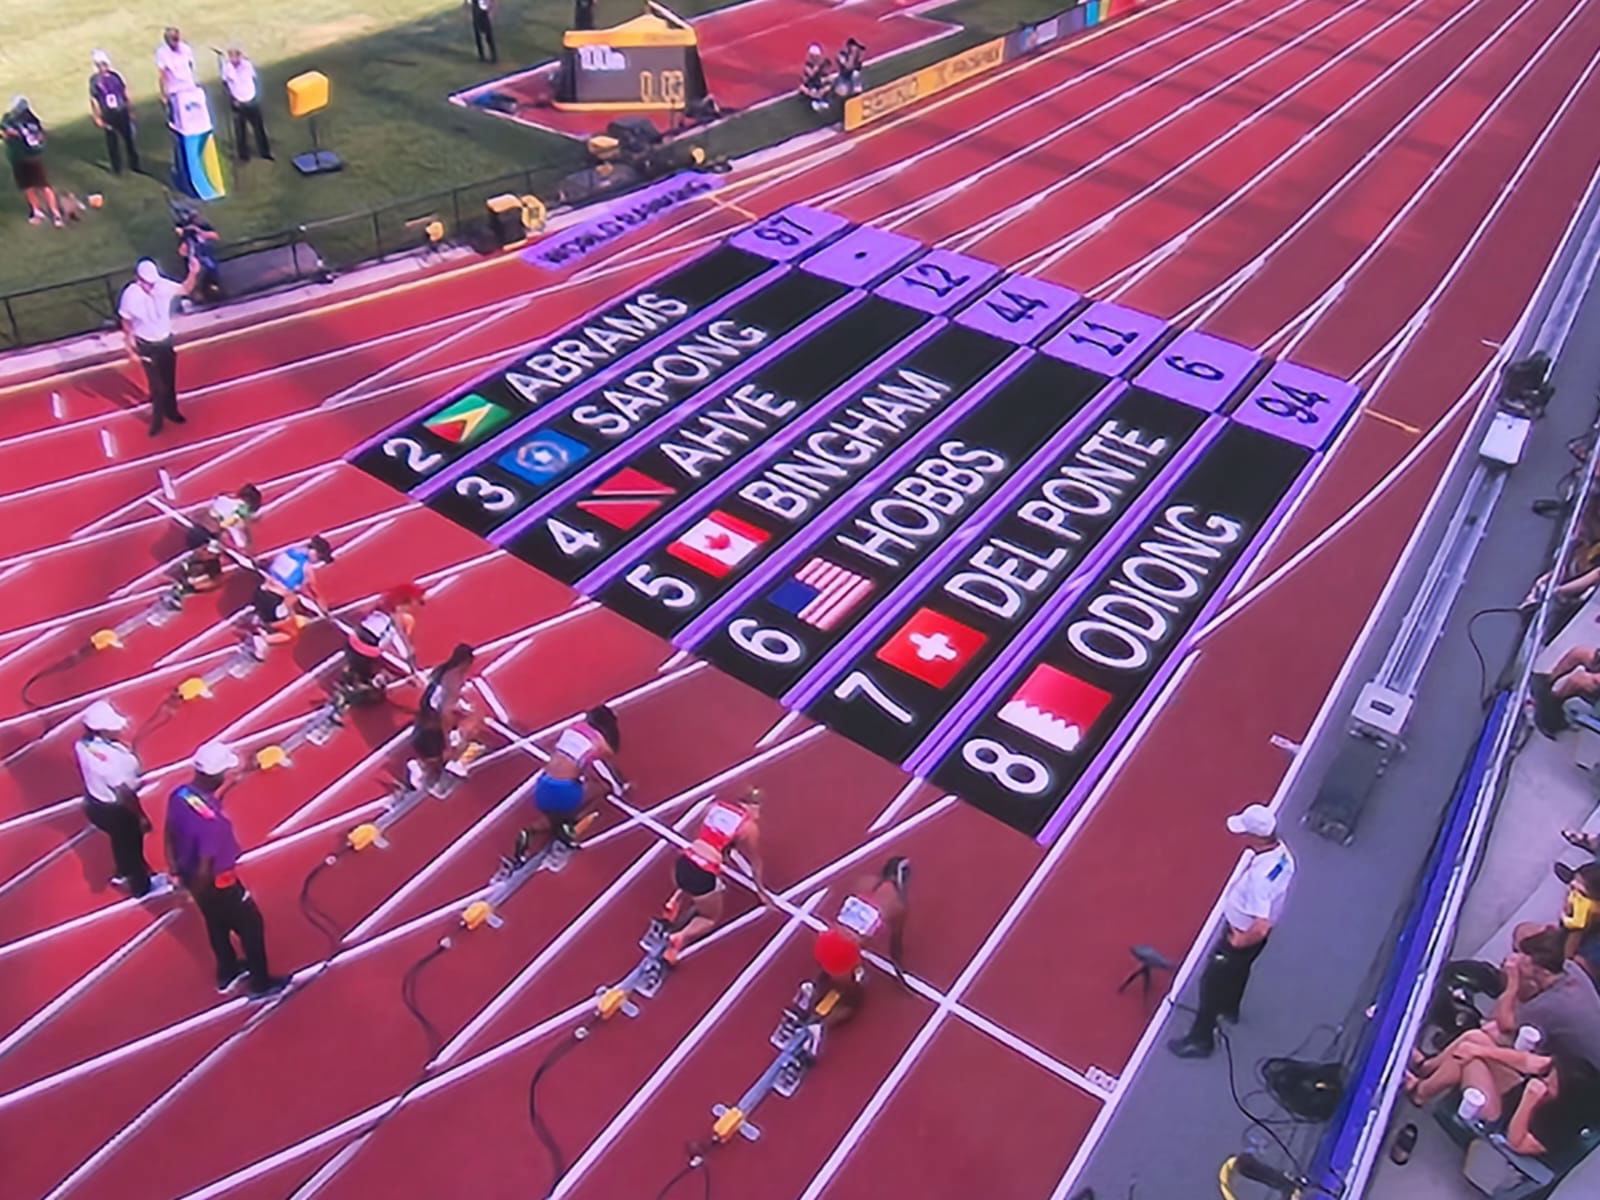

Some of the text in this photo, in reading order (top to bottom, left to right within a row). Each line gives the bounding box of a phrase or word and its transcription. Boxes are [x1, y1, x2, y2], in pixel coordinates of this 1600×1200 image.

[900, 263, 970, 297] 12
[983, 289, 1048, 323] 44
[1068, 320, 1139, 357] 11
[1165, 355, 1225, 381] 6
[383, 293, 688, 473] 2 ABRAMS
[455, 320, 767, 511] 3 SAPONG
[546, 384, 796, 554] 4 AHYE
[625, 369, 951, 608] 5 BINGHAM
[727, 441, 1004, 663] 6 HOBBS
[834, 420, 1166, 723] 7 DEL PONTE
[962, 505, 1241, 794] 8 ODIONG
